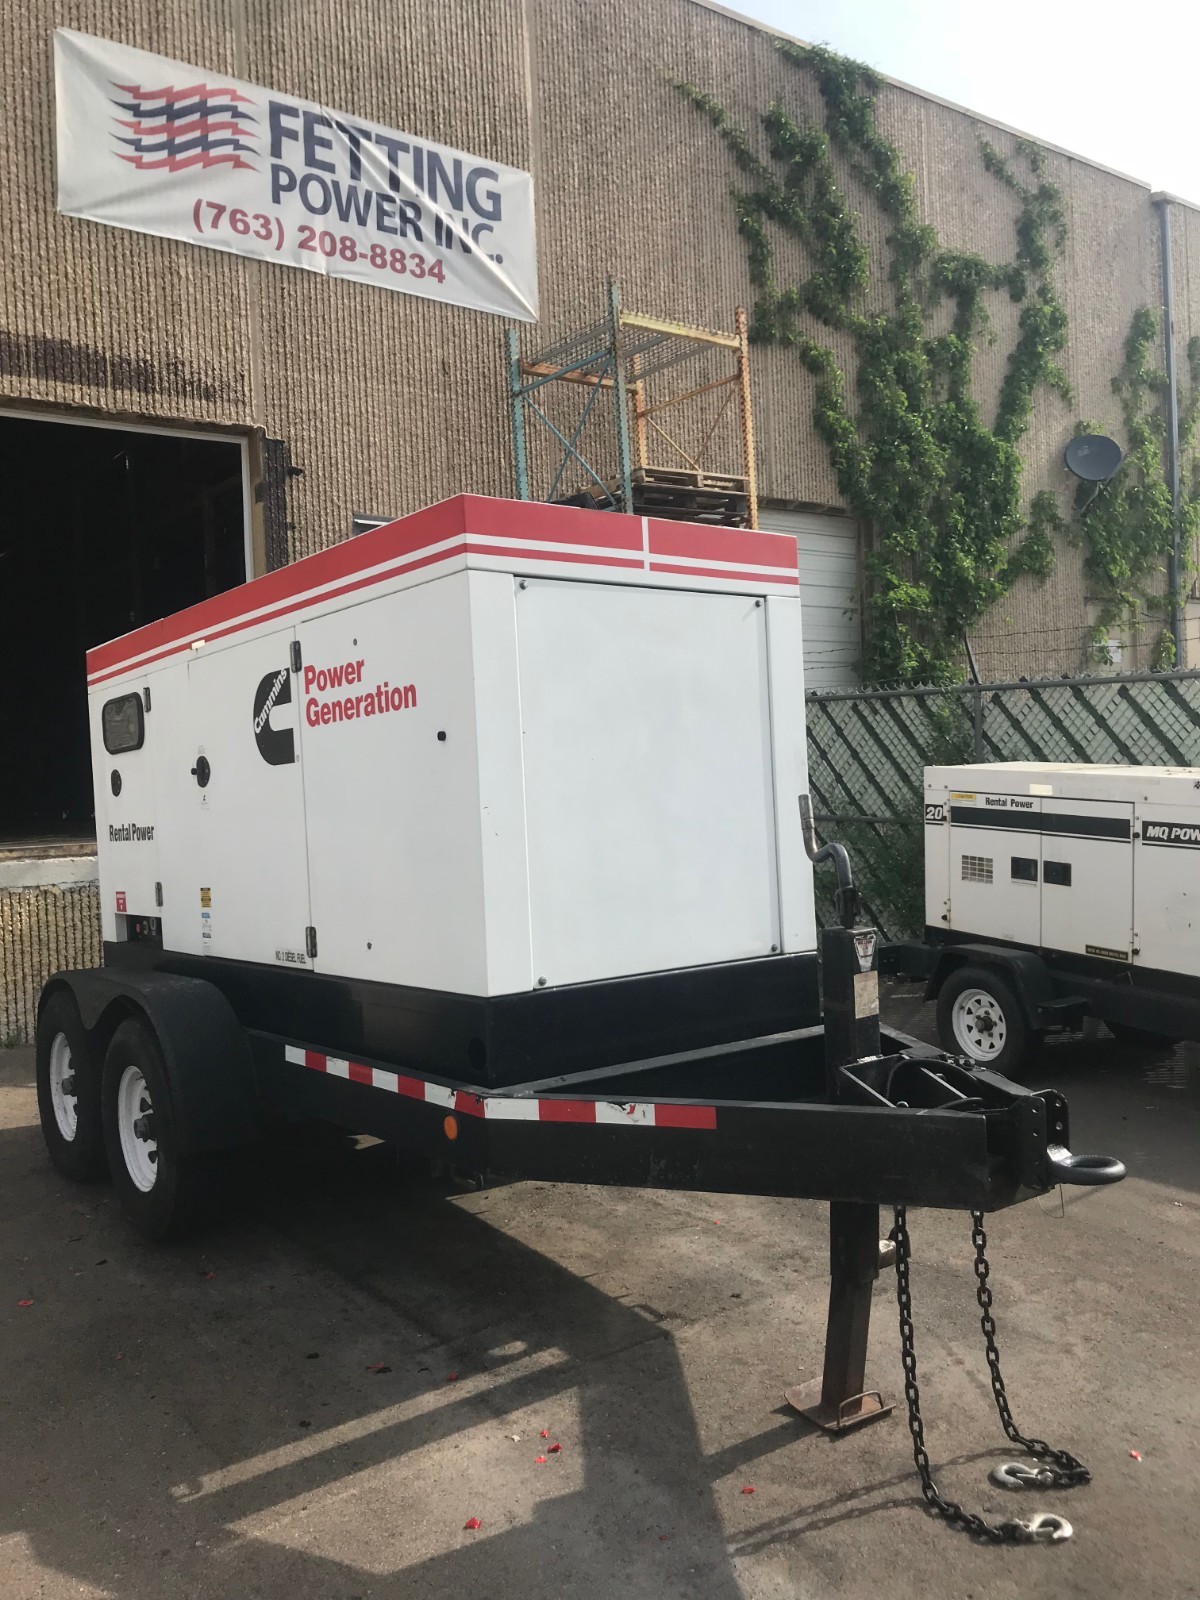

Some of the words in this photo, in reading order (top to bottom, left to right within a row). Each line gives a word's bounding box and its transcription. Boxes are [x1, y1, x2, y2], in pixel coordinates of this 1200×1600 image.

[268, 100, 502, 222] FETTING
[271, 164, 424, 243] POWER
[435, 211, 504, 265] INC.
[193, 198, 285, 251] (763)
[297, 223, 446, 284] 208-8834
[303, 659, 365, 694] Power
[254, 669, 288, 734] Cummins
[305, 682, 417, 728] Generation
[925, 806, 943, 820] 20
[985, 797, 1007, 807] Rental
[1010, 798, 1034, 809] Power
[109, 823, 131, 842] Rental
[131, 823, 155, 841] Power
[1146, 825, 1169, 840] MQ
